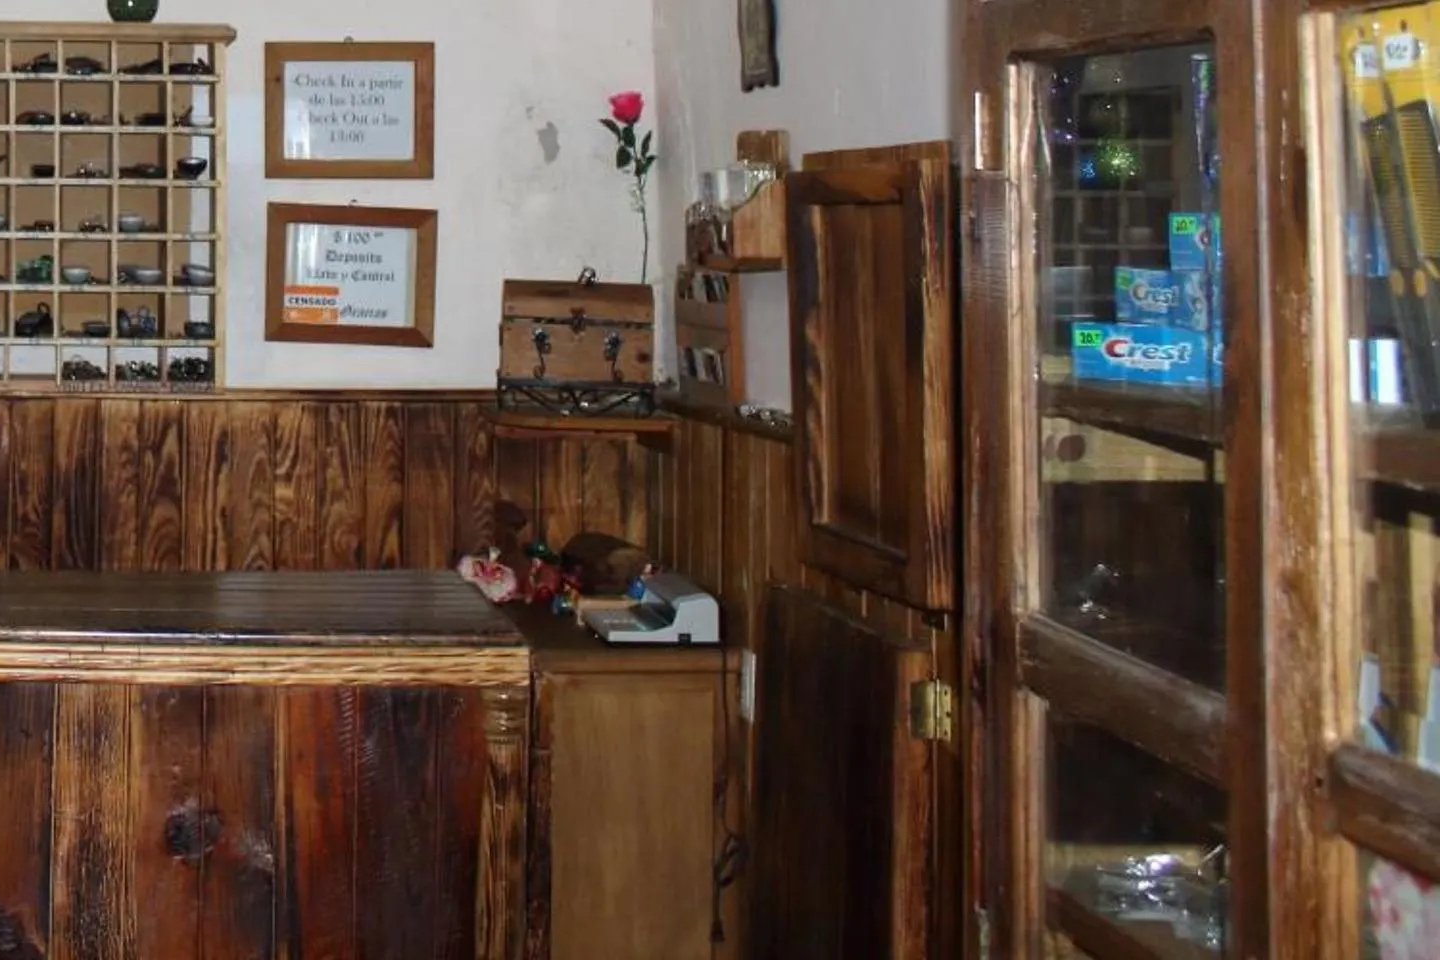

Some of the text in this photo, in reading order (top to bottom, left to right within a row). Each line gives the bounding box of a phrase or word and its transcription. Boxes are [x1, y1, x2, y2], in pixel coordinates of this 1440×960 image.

[288, 297, 337, 305] CENSADO
[1132, 282, 1179, 304] Crest
[1104, 339, 1191, 362] Crest
